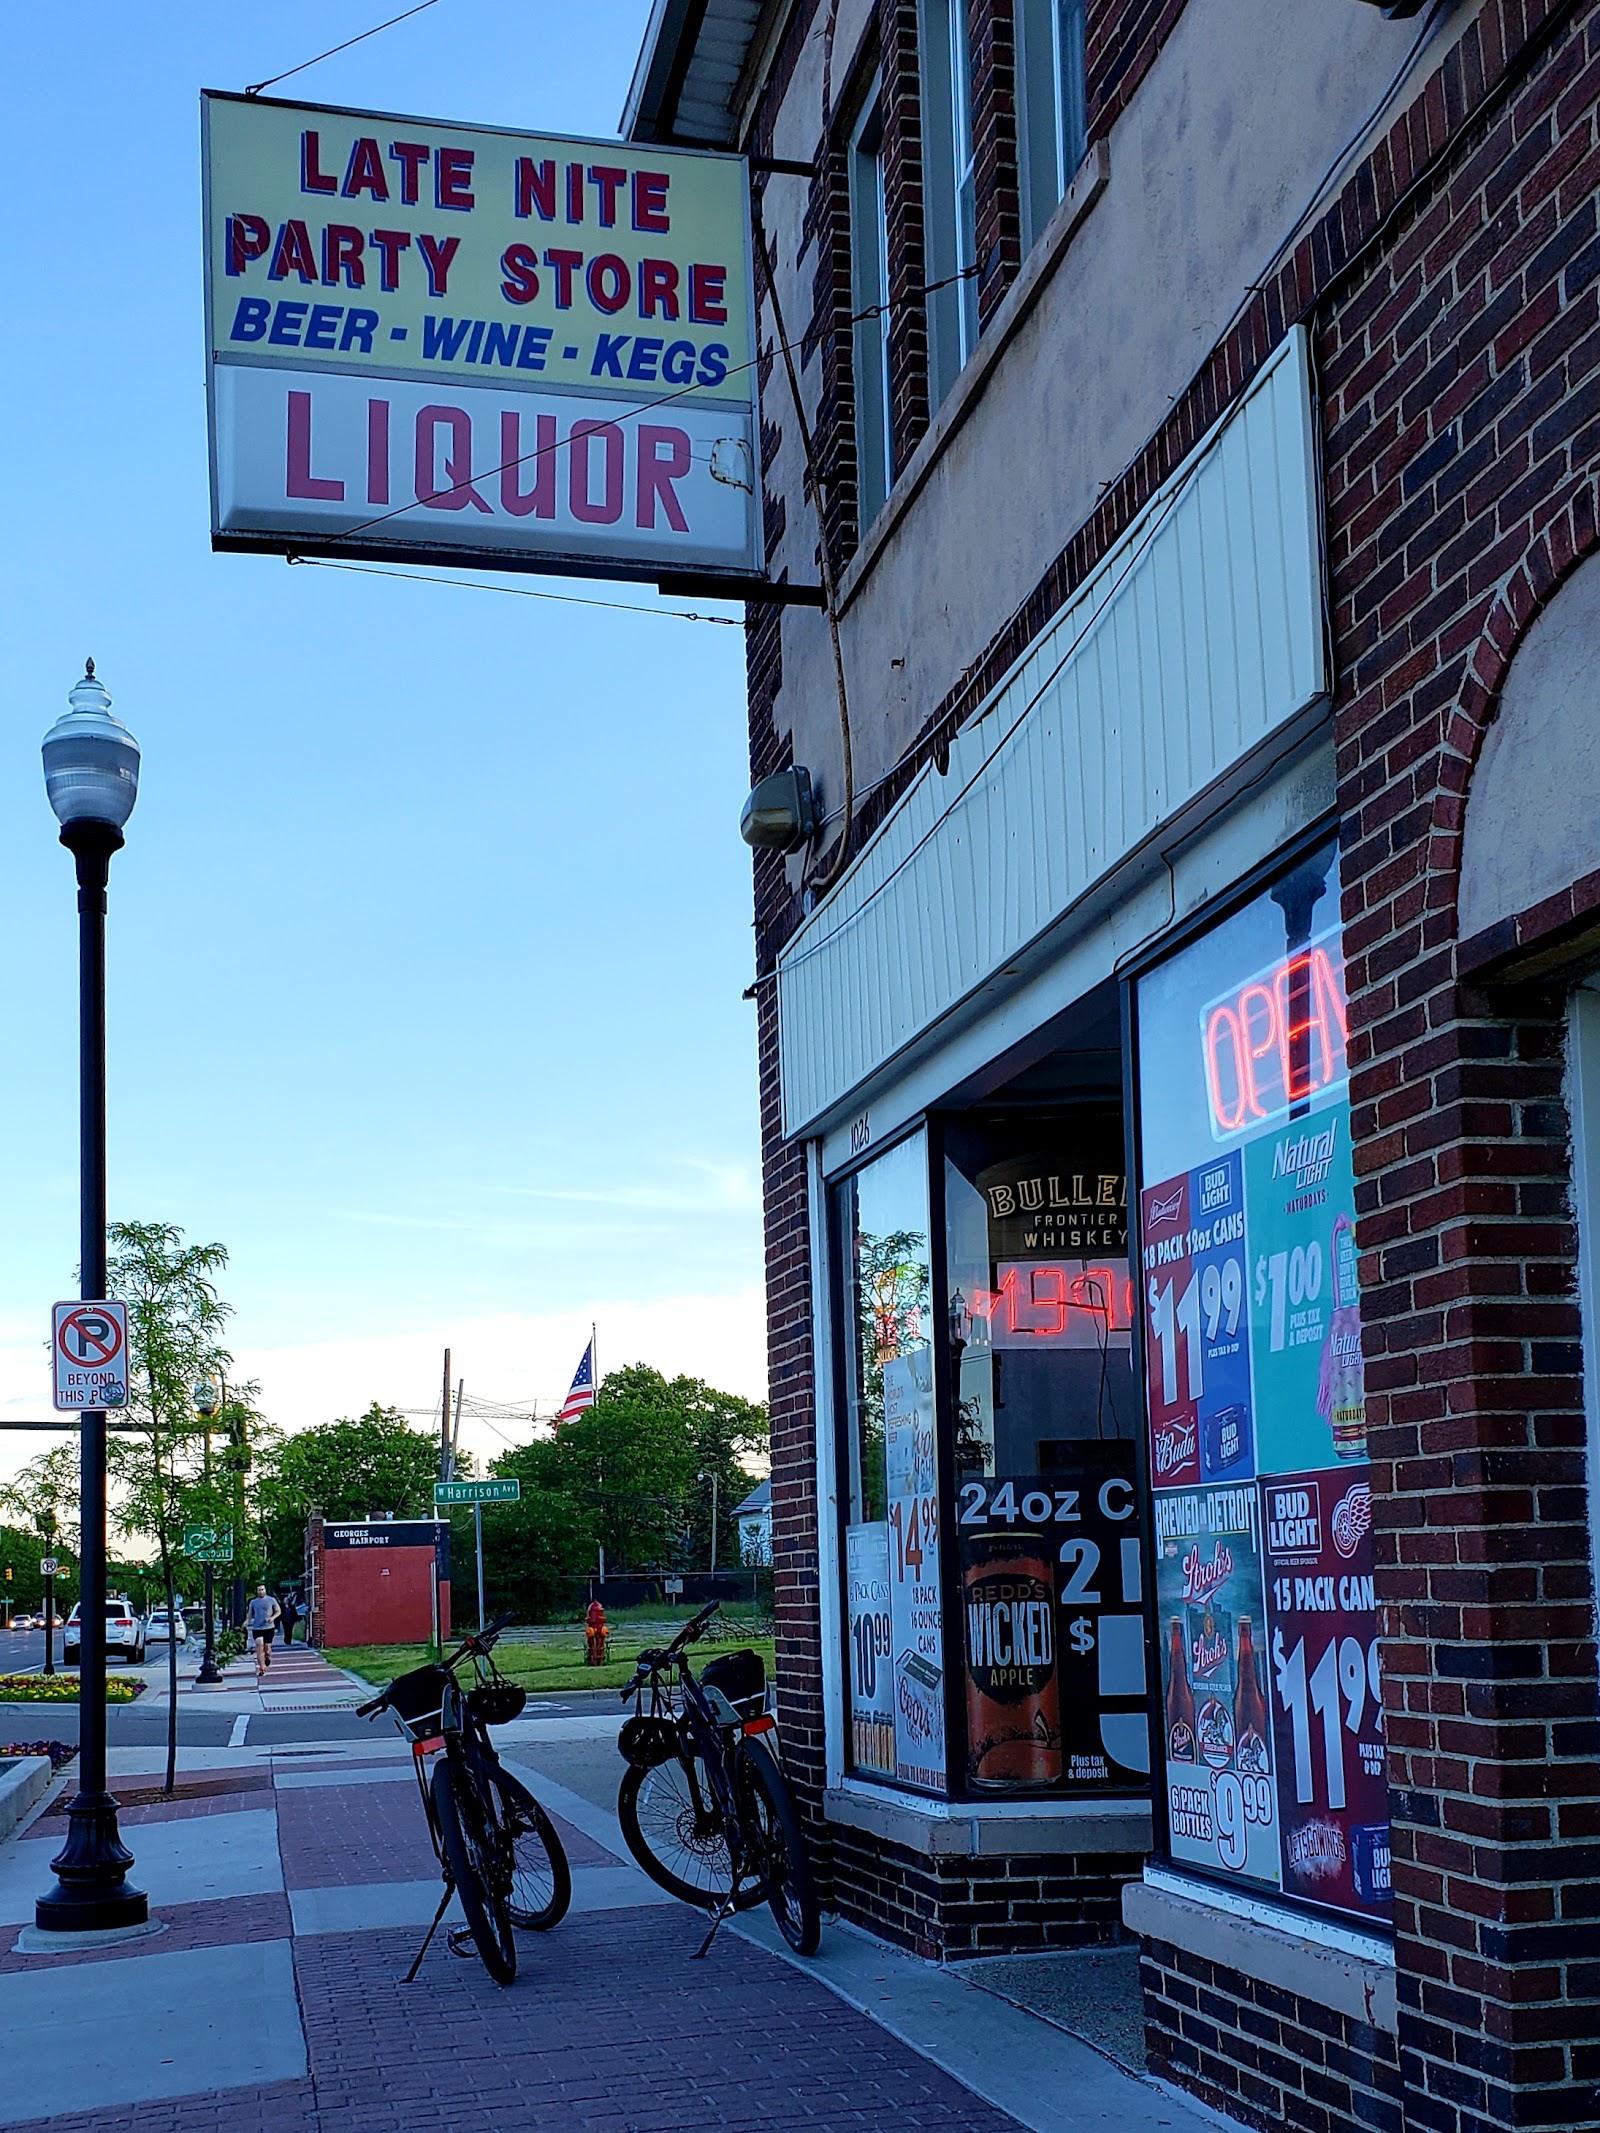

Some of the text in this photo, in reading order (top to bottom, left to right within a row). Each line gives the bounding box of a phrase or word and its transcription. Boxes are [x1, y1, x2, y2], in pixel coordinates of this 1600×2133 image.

[300, 130, 670, 234] LATE NITE
[225, 212, 727, 326] PARTY STORE
[230, 296, 379, 354] BEER
[423, 316, 553, 371] WINE
[590, 337, 729, 387] KEGS
[286, 390, 692, 533] LIQUOR
[1208, 947, 1350, 1129] OPEN
[850, 1111, 870, 1156] 1026
[1272, 1117, 1338, 1180] Natural
[1205, 1170, 1225, 1192] BUD
[1296, 1158, 1333, 1191] LIGHT
[988, 1174, 1128, 1218] BULLE
[1202, 1184, 1229, 1211] LIGHT
[1035, 1213, 1117, 1227] FRONTIER
[1024, 1230, 1128, 1248] WHISKEY
[1143, 1211, 1244, 1270] 18 PACK 12oz CANS
[1290, 1308, 1321, 1329] PLUS TAX
[1296, 1325, 1323, 1346] DEPOSIT
[68, 1373, 115, 1386] BEYOND
[59, 1390, 84, 1403] THIS
[1221, 1423, 1238, 1443] BUD
[1220, 1436, 1239, 1459] LIGHT
[438, 1484, 515, 1499] W Harrison Ave
[960, 1481, 1081, 1525] 24oz
[1274, 1491, 1309, 1520] BUD
[333, 1529, 369, 1538] GEORGES
[1155, 1495, 1199, 1559] BREWED
[1207, 1487, 1257, 1553] DETROIT
[1270, 1518, 1317, 1548] LIGHT
[349, 1536, 389, 1545] HAIRPORT
[1182, 1540, 1233, 1602] Stroh's
[920, 1585, 937, 1604] PACK
[972, 1580, 1045, 1602] REDD'S
[1273, 1577, 1291, 1611] 15
[1295, 1576, 1336, 1611] PACK
[918, 1610, 942, 1629] OUNCE
[918, 1635, 936, 1654] CANS
[968, 1602, 1052, 1667] WICKED
[1193, 1631, 1228, 1673] Stroh's
[991, 1668, 1034, 1687] APPLE
[1071, 1755, 1104, 1767] Plus tax
[1359, 1743, 1385, 1760] PLUS TAX
[1068, 1765, 1109, 1780] & deposit
[1370, 1761, 1382, 1776] DEP
[1171, 1785, 1209, 1816] 6 PACK
[1172, 1810, 1212, 1841] BOTTLES
